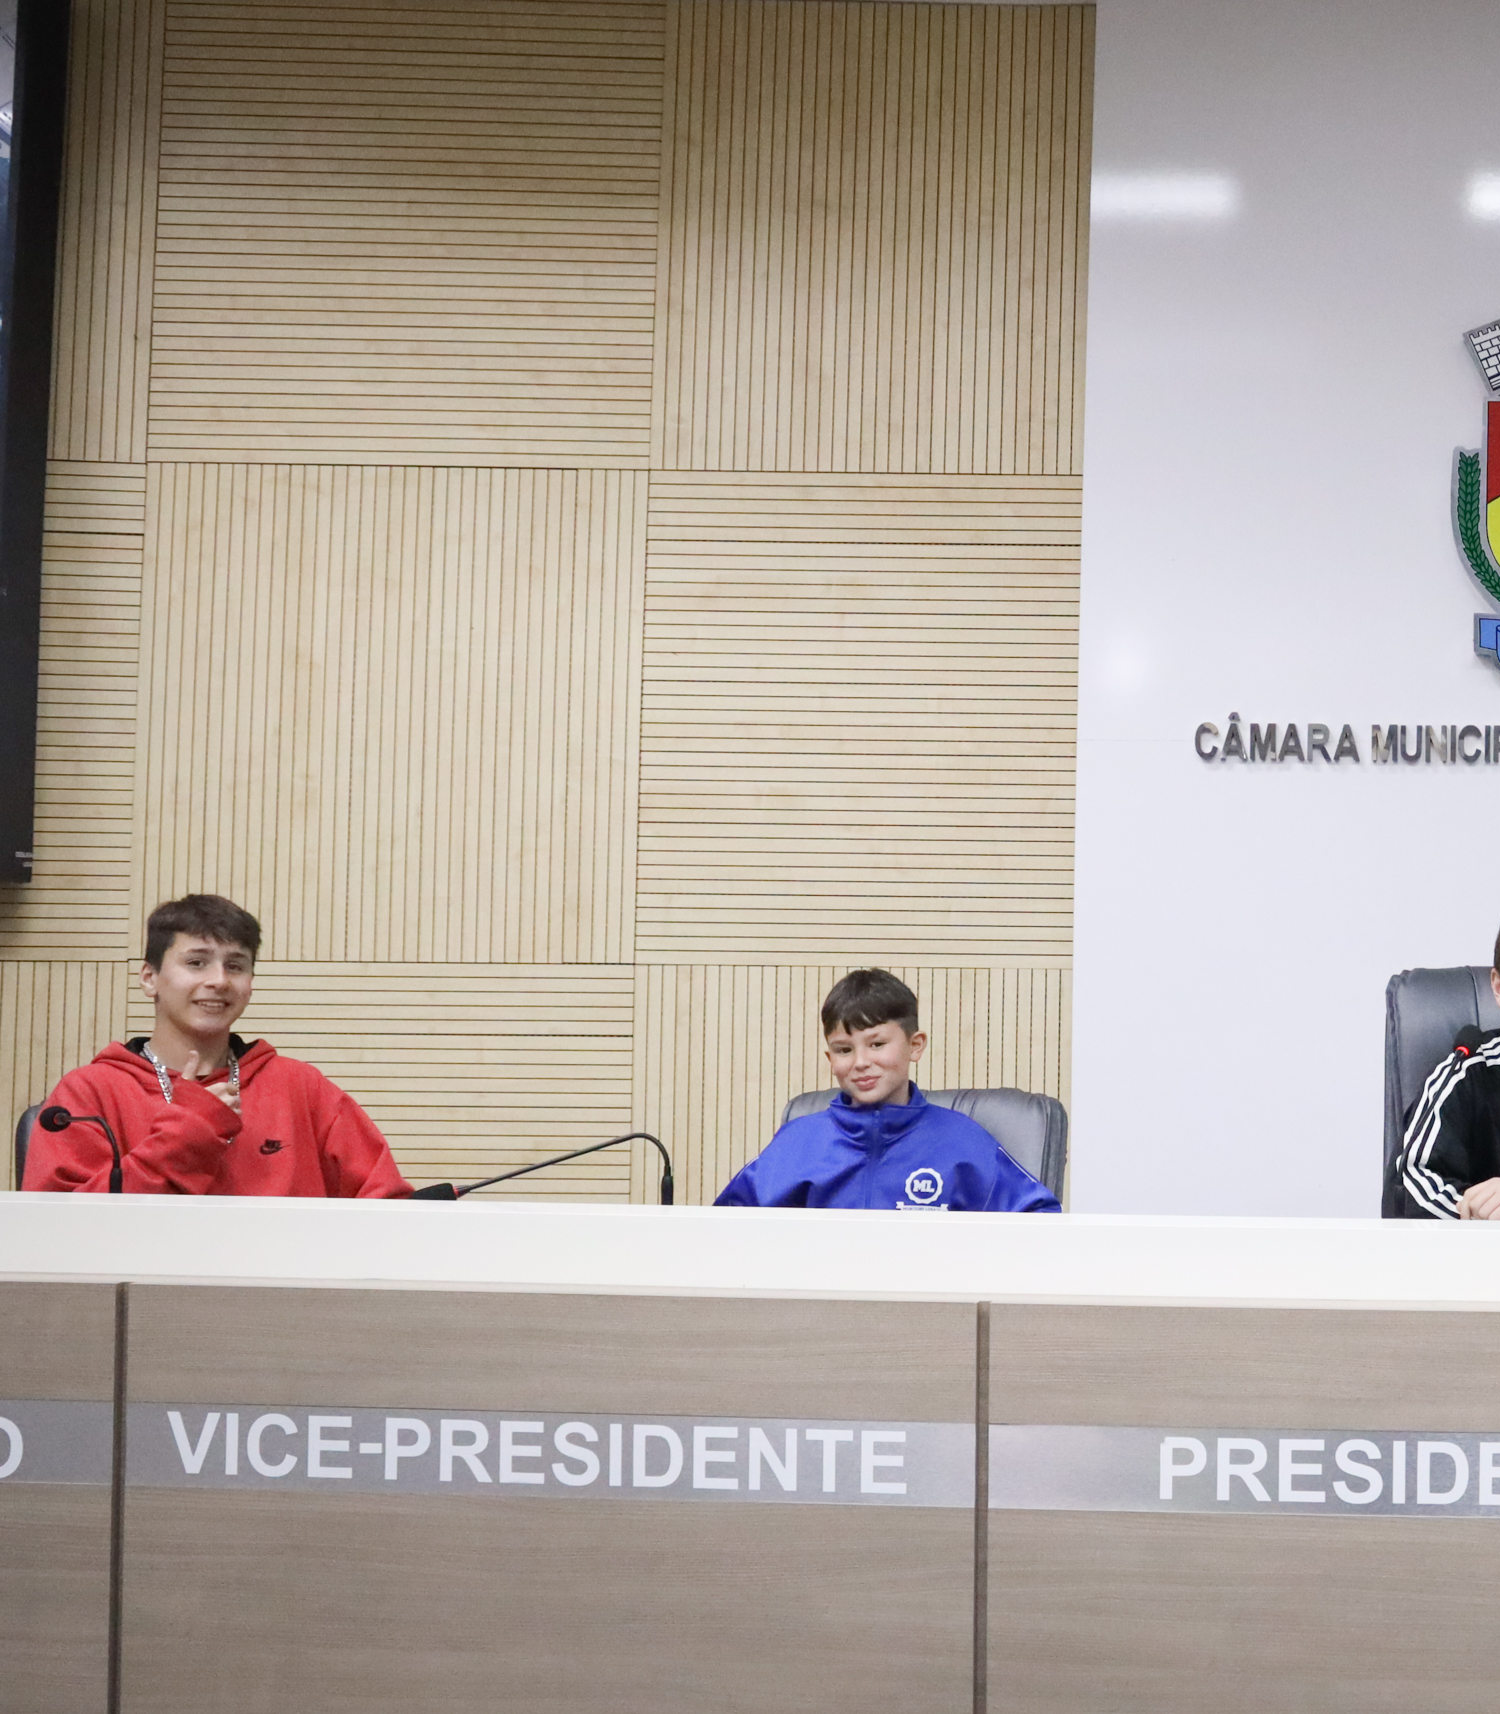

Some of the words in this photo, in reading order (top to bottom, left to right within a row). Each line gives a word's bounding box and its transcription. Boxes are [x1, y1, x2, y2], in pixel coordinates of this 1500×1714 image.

[1195, 711, 1360, 764] CÂMARA
[912, 1179, 935, 1193] ML
[168, 1410, 908, 1495] VICE-PRESIDENTE
